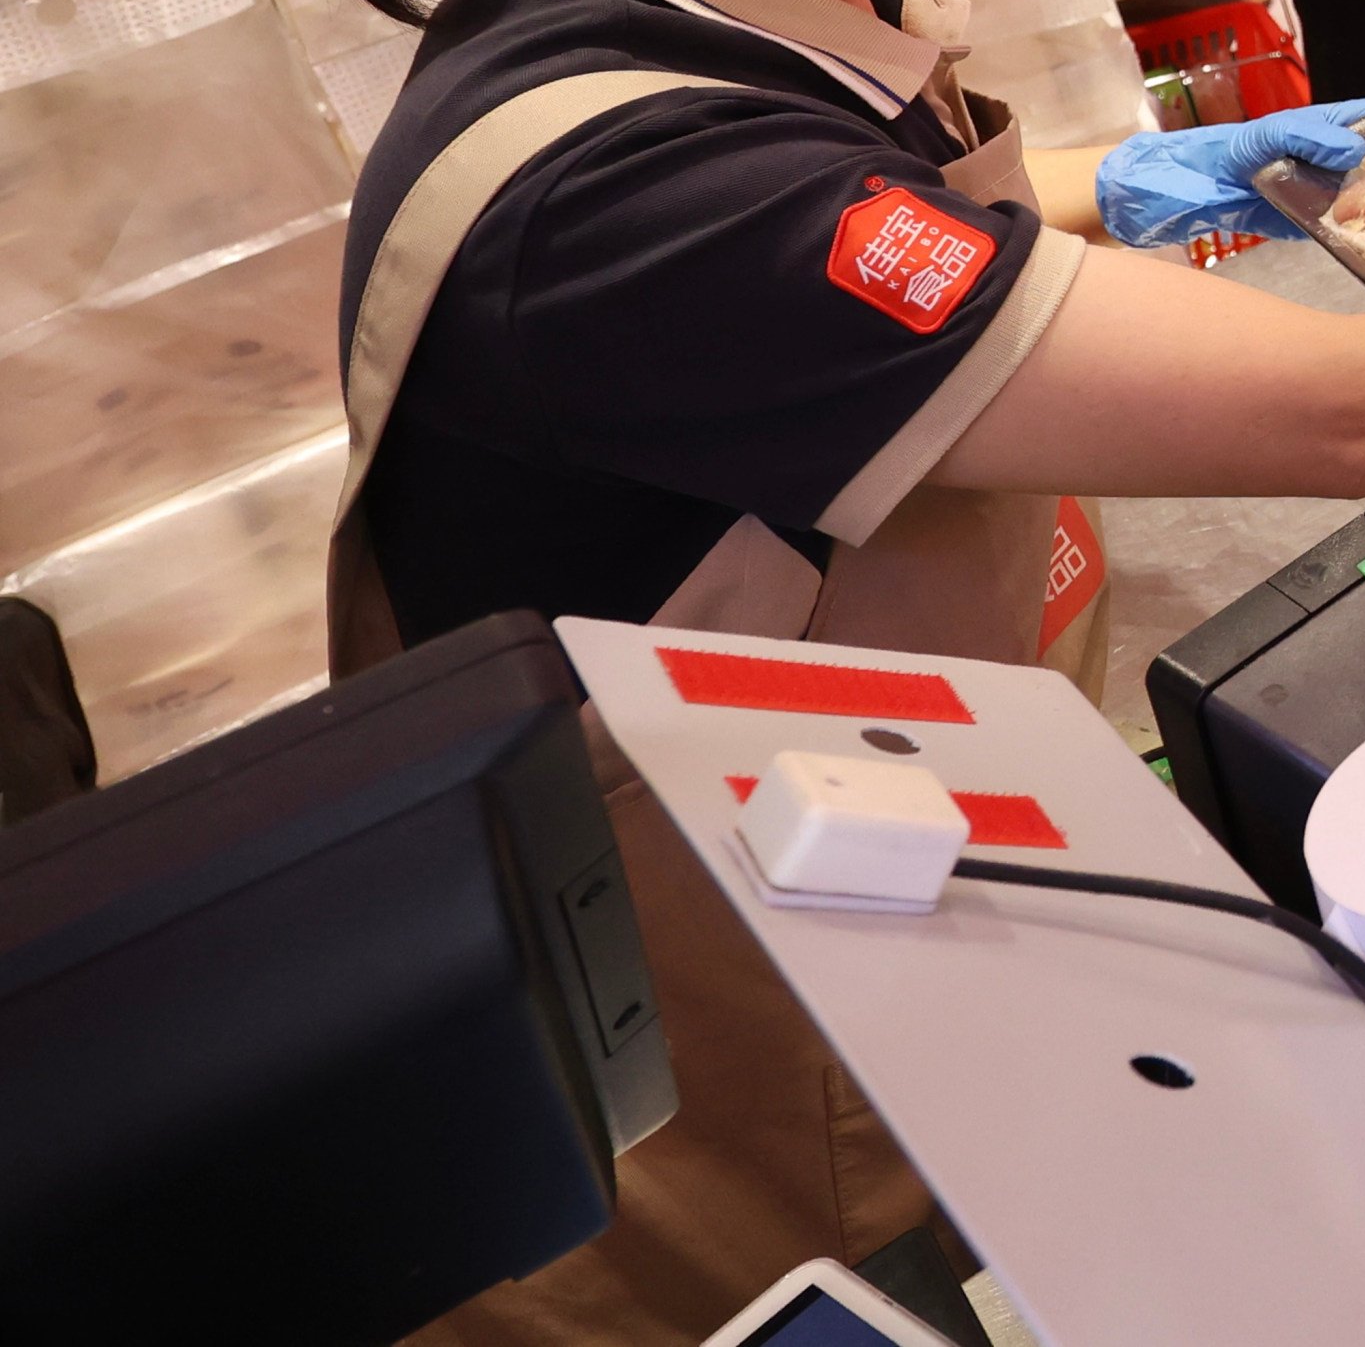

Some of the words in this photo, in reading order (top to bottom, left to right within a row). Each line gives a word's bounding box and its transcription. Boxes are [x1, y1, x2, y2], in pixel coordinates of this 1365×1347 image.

[855, 205, 928, 285] 佳宝
[887, 256, 918, 291] KAI
[920, 226, 940, 247] BO
[903, 233, 978, 312] 食品
[1045, 525, 1088, 603] 品
